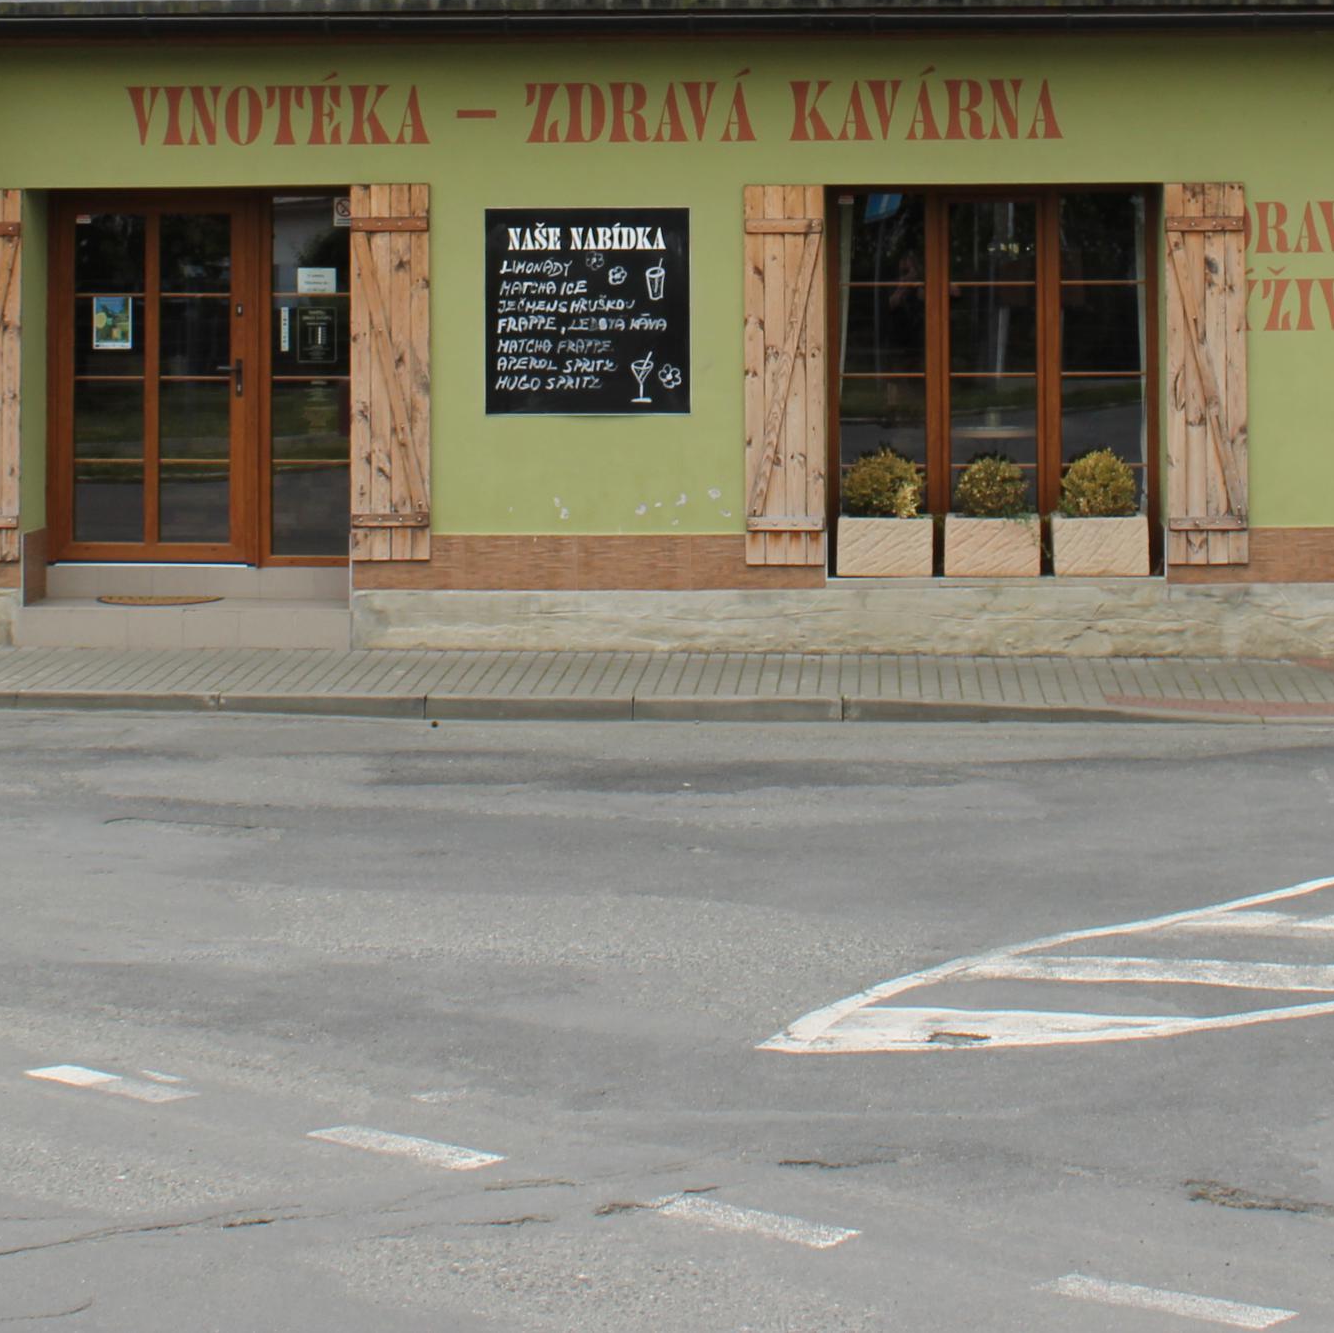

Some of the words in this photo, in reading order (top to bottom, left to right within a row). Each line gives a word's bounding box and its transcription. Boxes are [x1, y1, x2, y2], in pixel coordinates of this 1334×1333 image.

[125, 72, 432, 147] VINOTÉKA
[524, 68, 758, 144] ZDRAVÁ
[788, 65, 1064, 142] KAVÁRNA
[507, 222, 562, 251] NAŠE
[569, 222, 667, 251] NABÍDKA
[499, 280, 557, 296] MATCHA
[560, 280, 588, 296] ICE
[496, 356, 558, 371] APEROL
[495, 375, 541, 391] HUGO
[545, 375, 602, 390] SPRITZ
